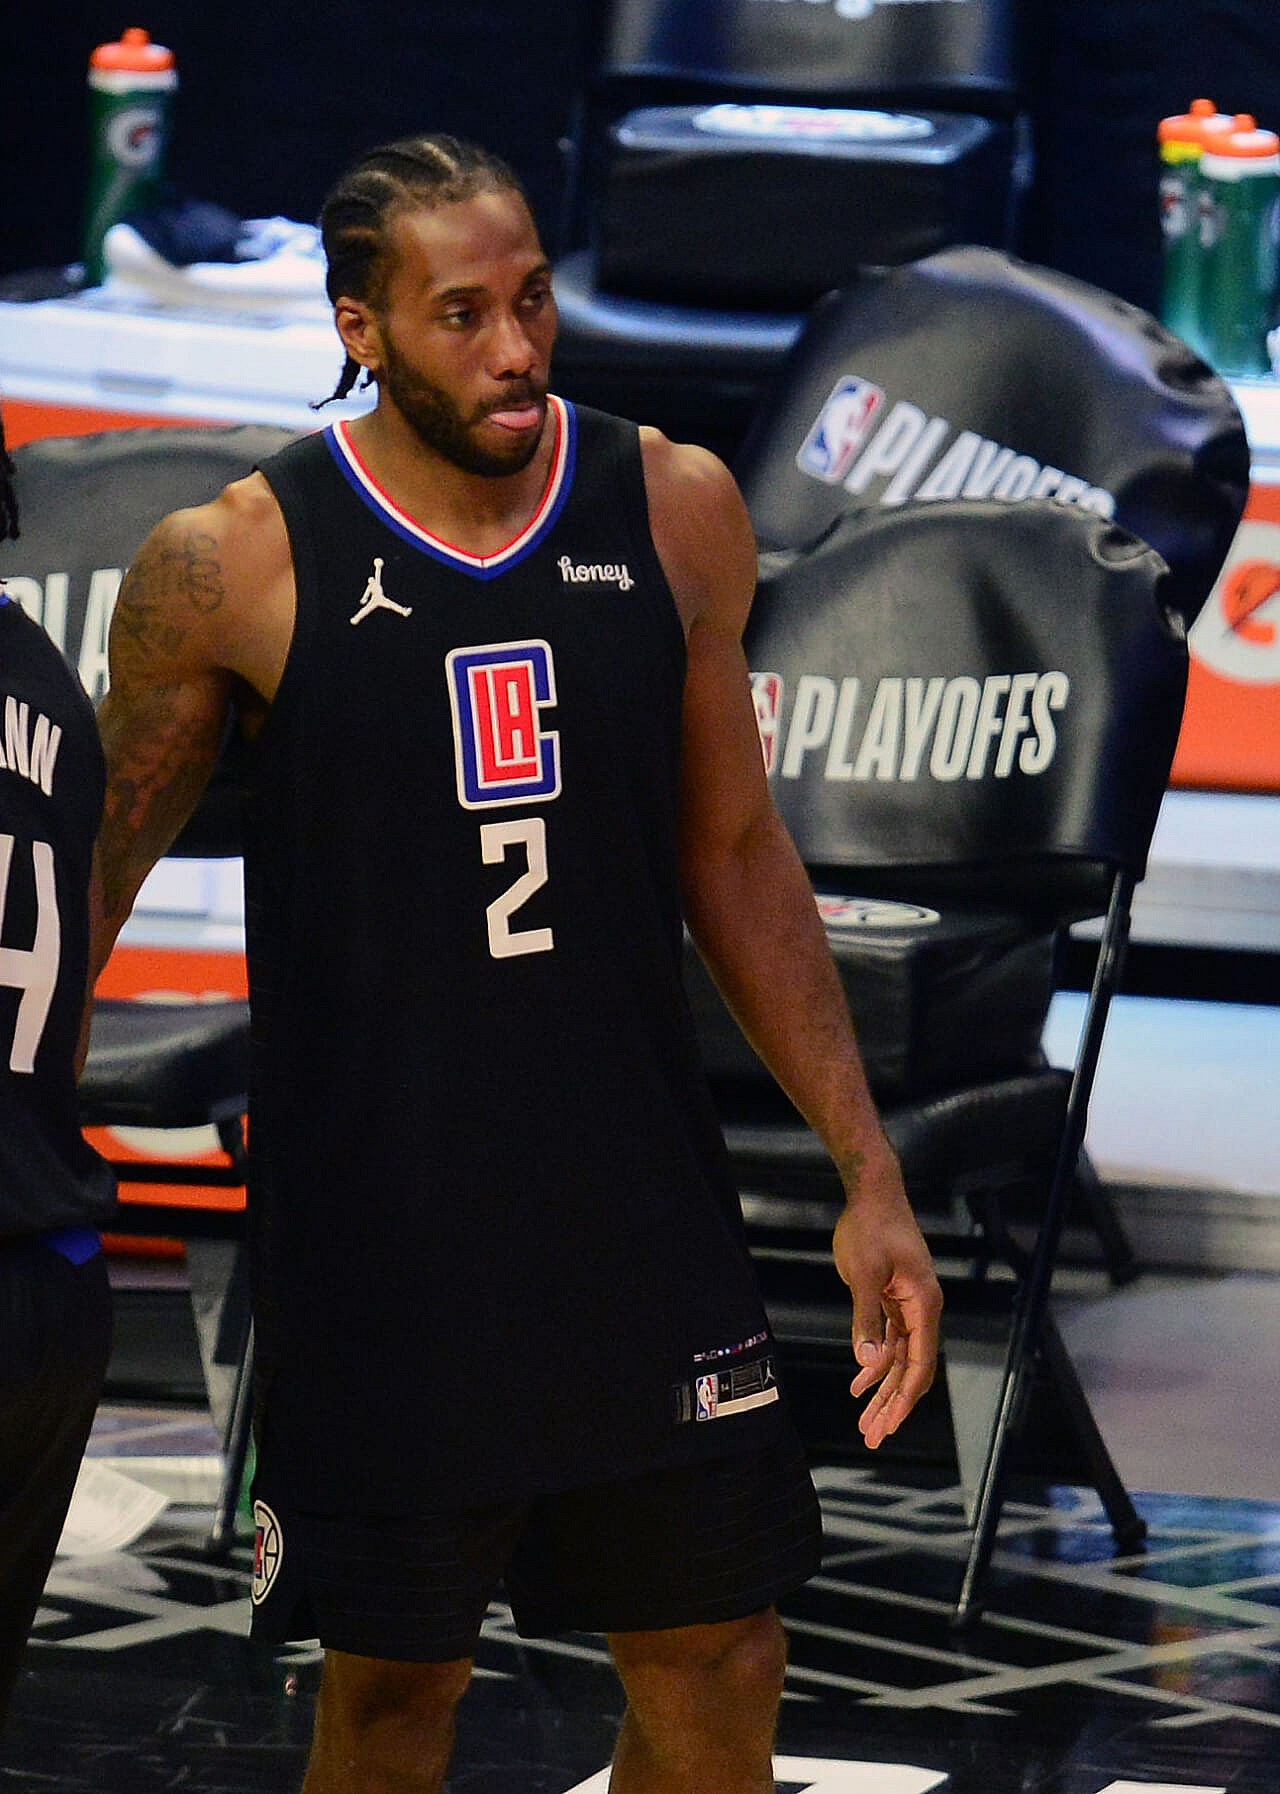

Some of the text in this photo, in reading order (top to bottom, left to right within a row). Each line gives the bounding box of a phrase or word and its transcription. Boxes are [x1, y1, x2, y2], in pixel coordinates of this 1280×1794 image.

[557, 555, 634, 590] honey
[781, 671, 1070, 781] PLAYOFFS
[480, 818, 554, 959] 2
